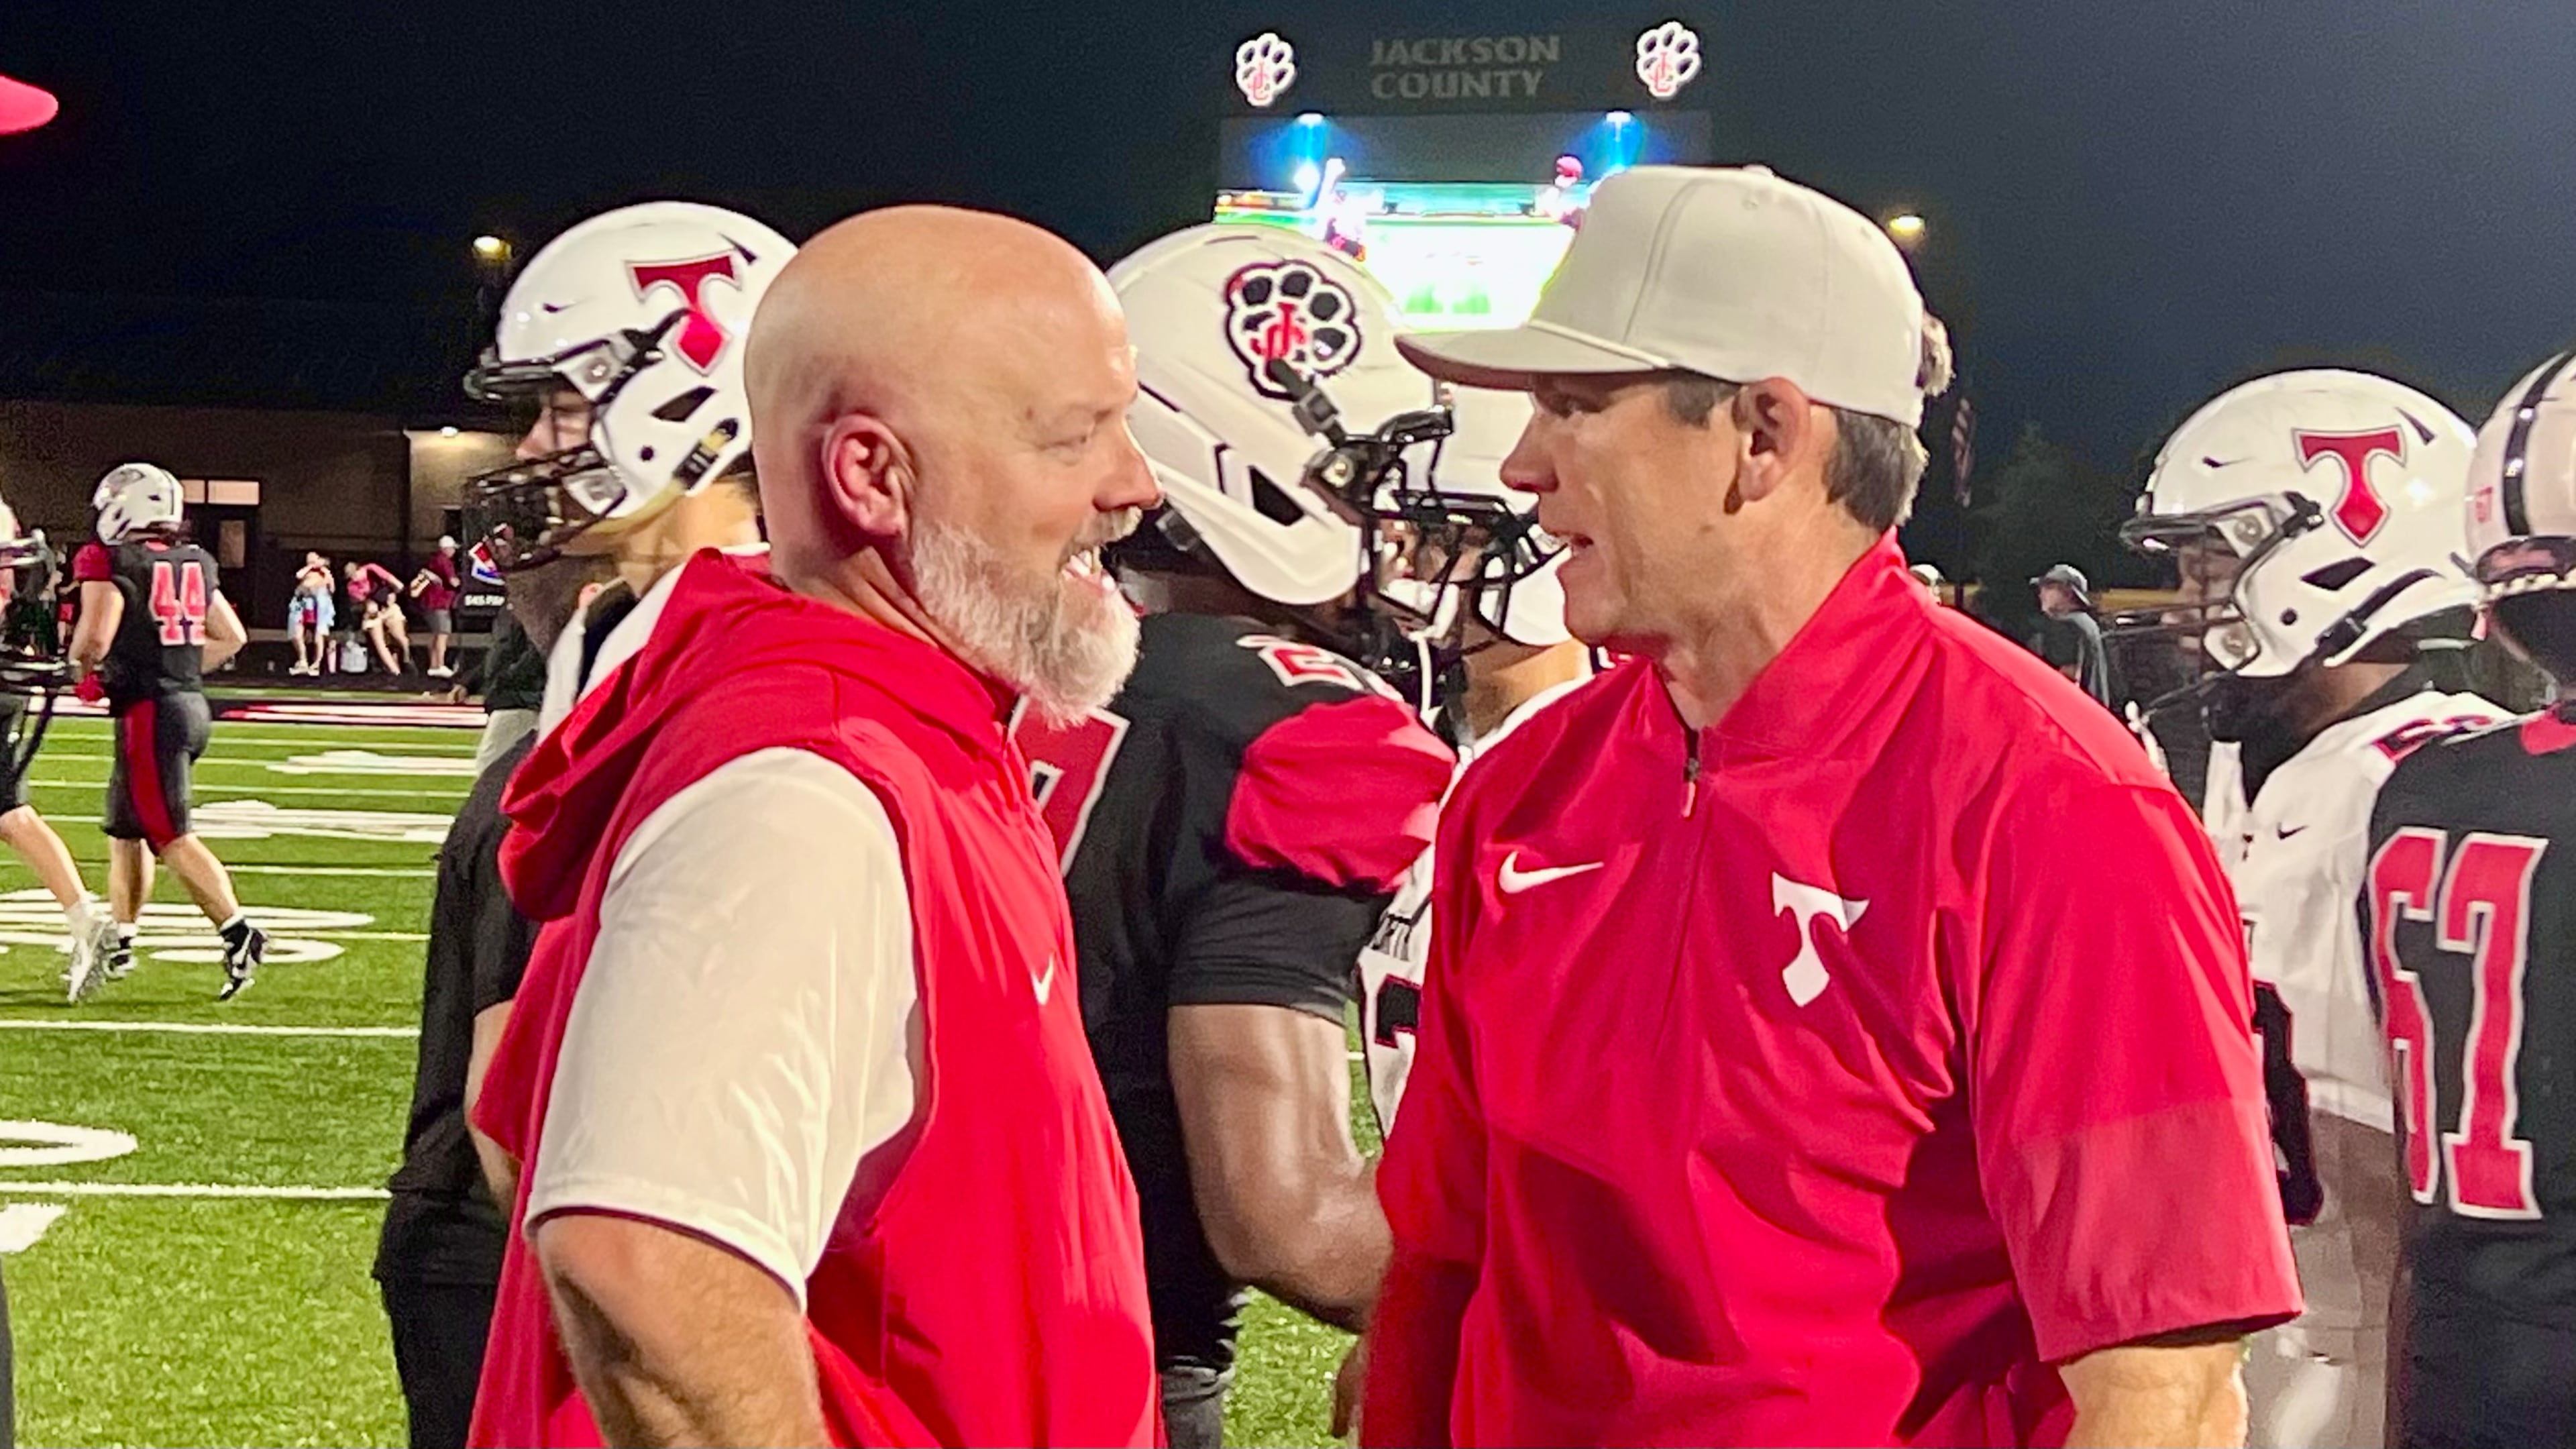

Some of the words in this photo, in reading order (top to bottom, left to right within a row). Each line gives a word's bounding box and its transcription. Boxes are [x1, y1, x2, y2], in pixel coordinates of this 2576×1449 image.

[1371, 36, 1560, 65] JACKSON
[1373, 70, 1543, 99] COUNTY
[2292, 425, 2407, 547] T
[148, 561, 206, 645] 44
[2368, 826, 2547, 1220] 67
